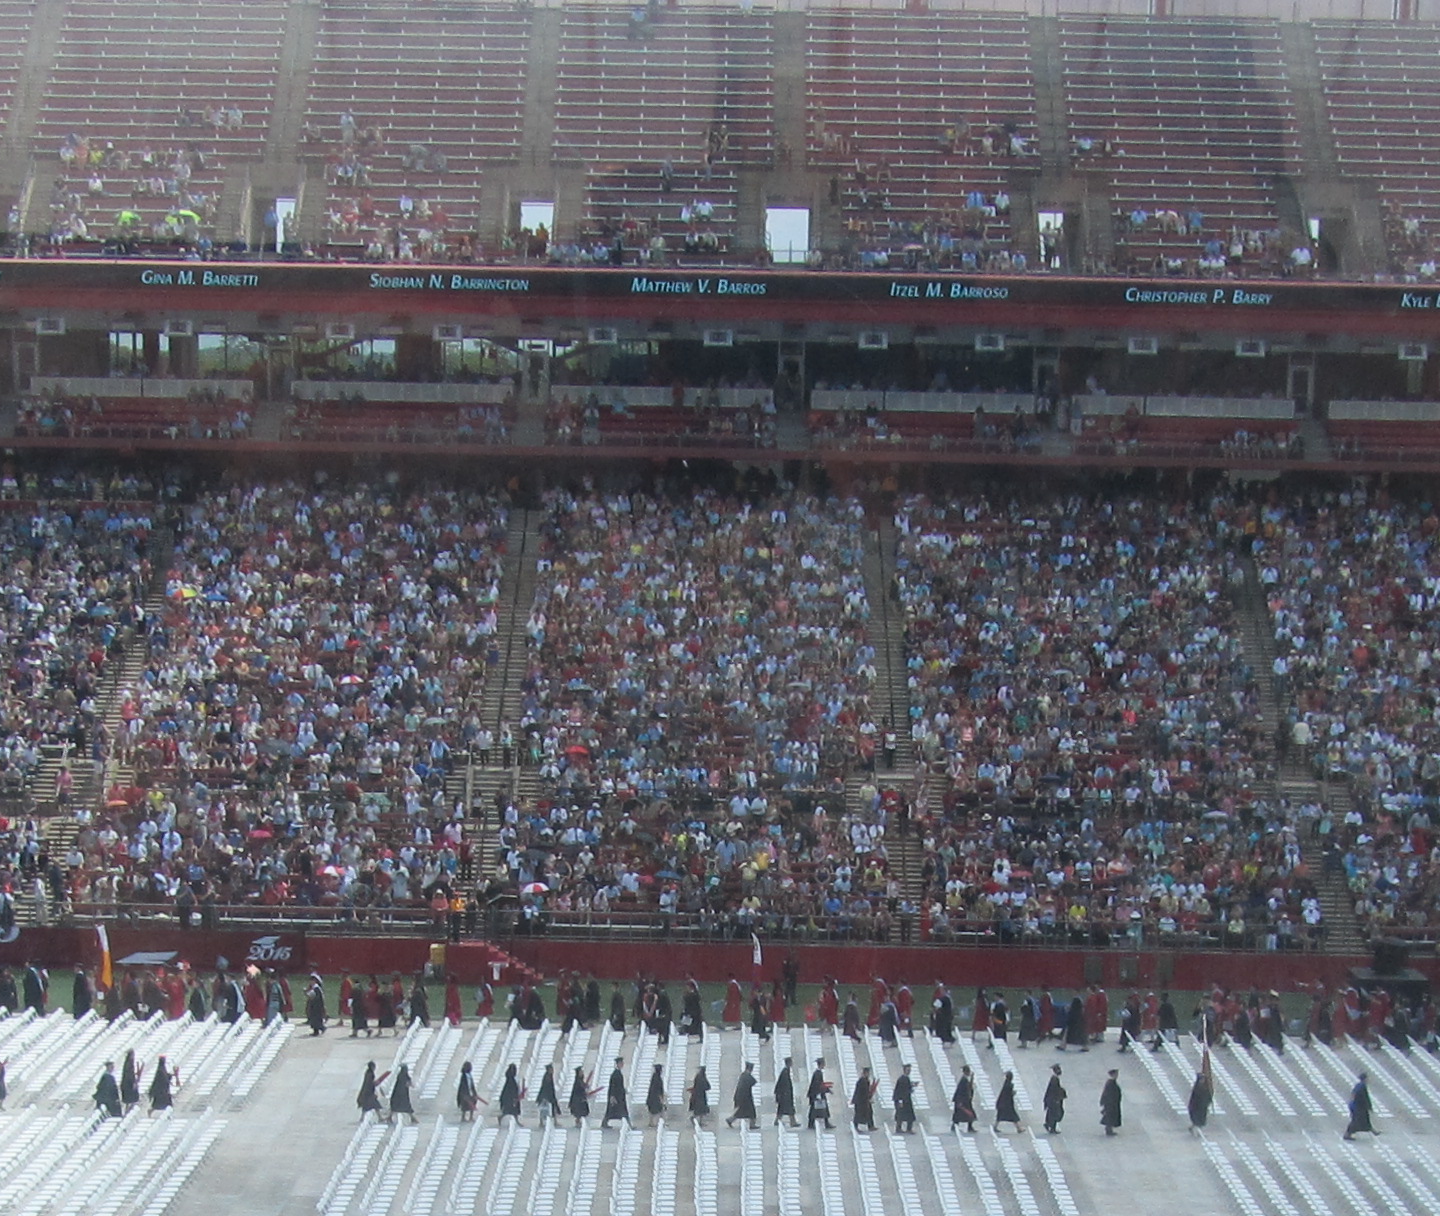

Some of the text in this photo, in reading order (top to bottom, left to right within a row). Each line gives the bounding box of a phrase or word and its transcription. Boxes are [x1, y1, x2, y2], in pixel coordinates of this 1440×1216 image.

[141, 270, 173, 285] GINA
[177, 271, 196, 285] M.
[369, 272, 529, 291] SIOBHAN N. BARRINGTON
[631, 277, 767, 295] MATTHEW V. BARROS
[890, 282, 1008, 299] ITZEL M. BARROSO
[1125, 287, 1207, 304] CHRISTOPHER
[1232, 289, 1273, 305] BARRY
[1401, 292, 1431, 308] KYLE
[245, 944, 293, 961] 2015
